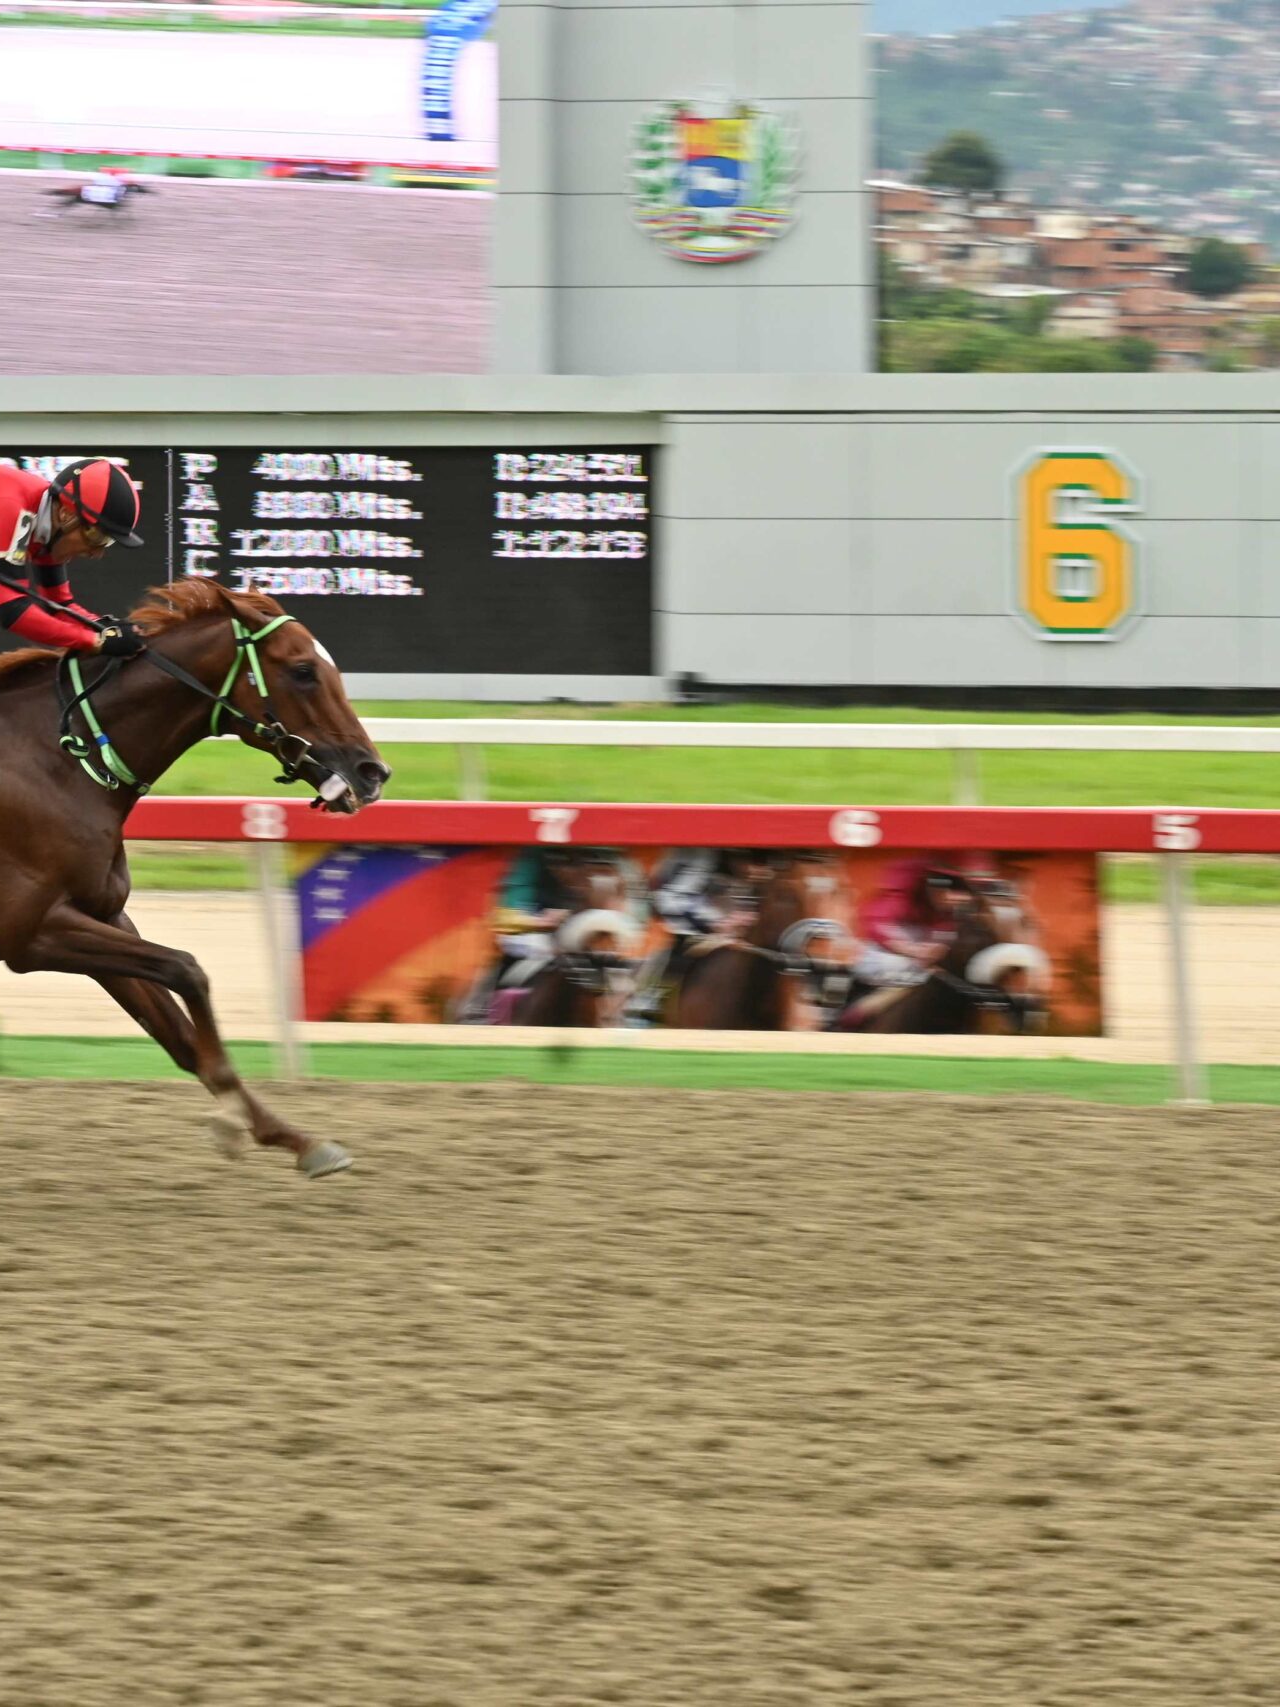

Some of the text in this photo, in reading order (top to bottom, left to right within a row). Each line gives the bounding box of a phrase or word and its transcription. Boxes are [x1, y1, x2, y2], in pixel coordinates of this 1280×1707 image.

[229, 529, 334, 557] 1200
[1009, 448, 1144, 638] 6
[241, 803, 288, 839] 8
[528, 808, 581, 843] 7
[829, 809, 883, 847] 6
[1151, 813, 1203, 850] 5
